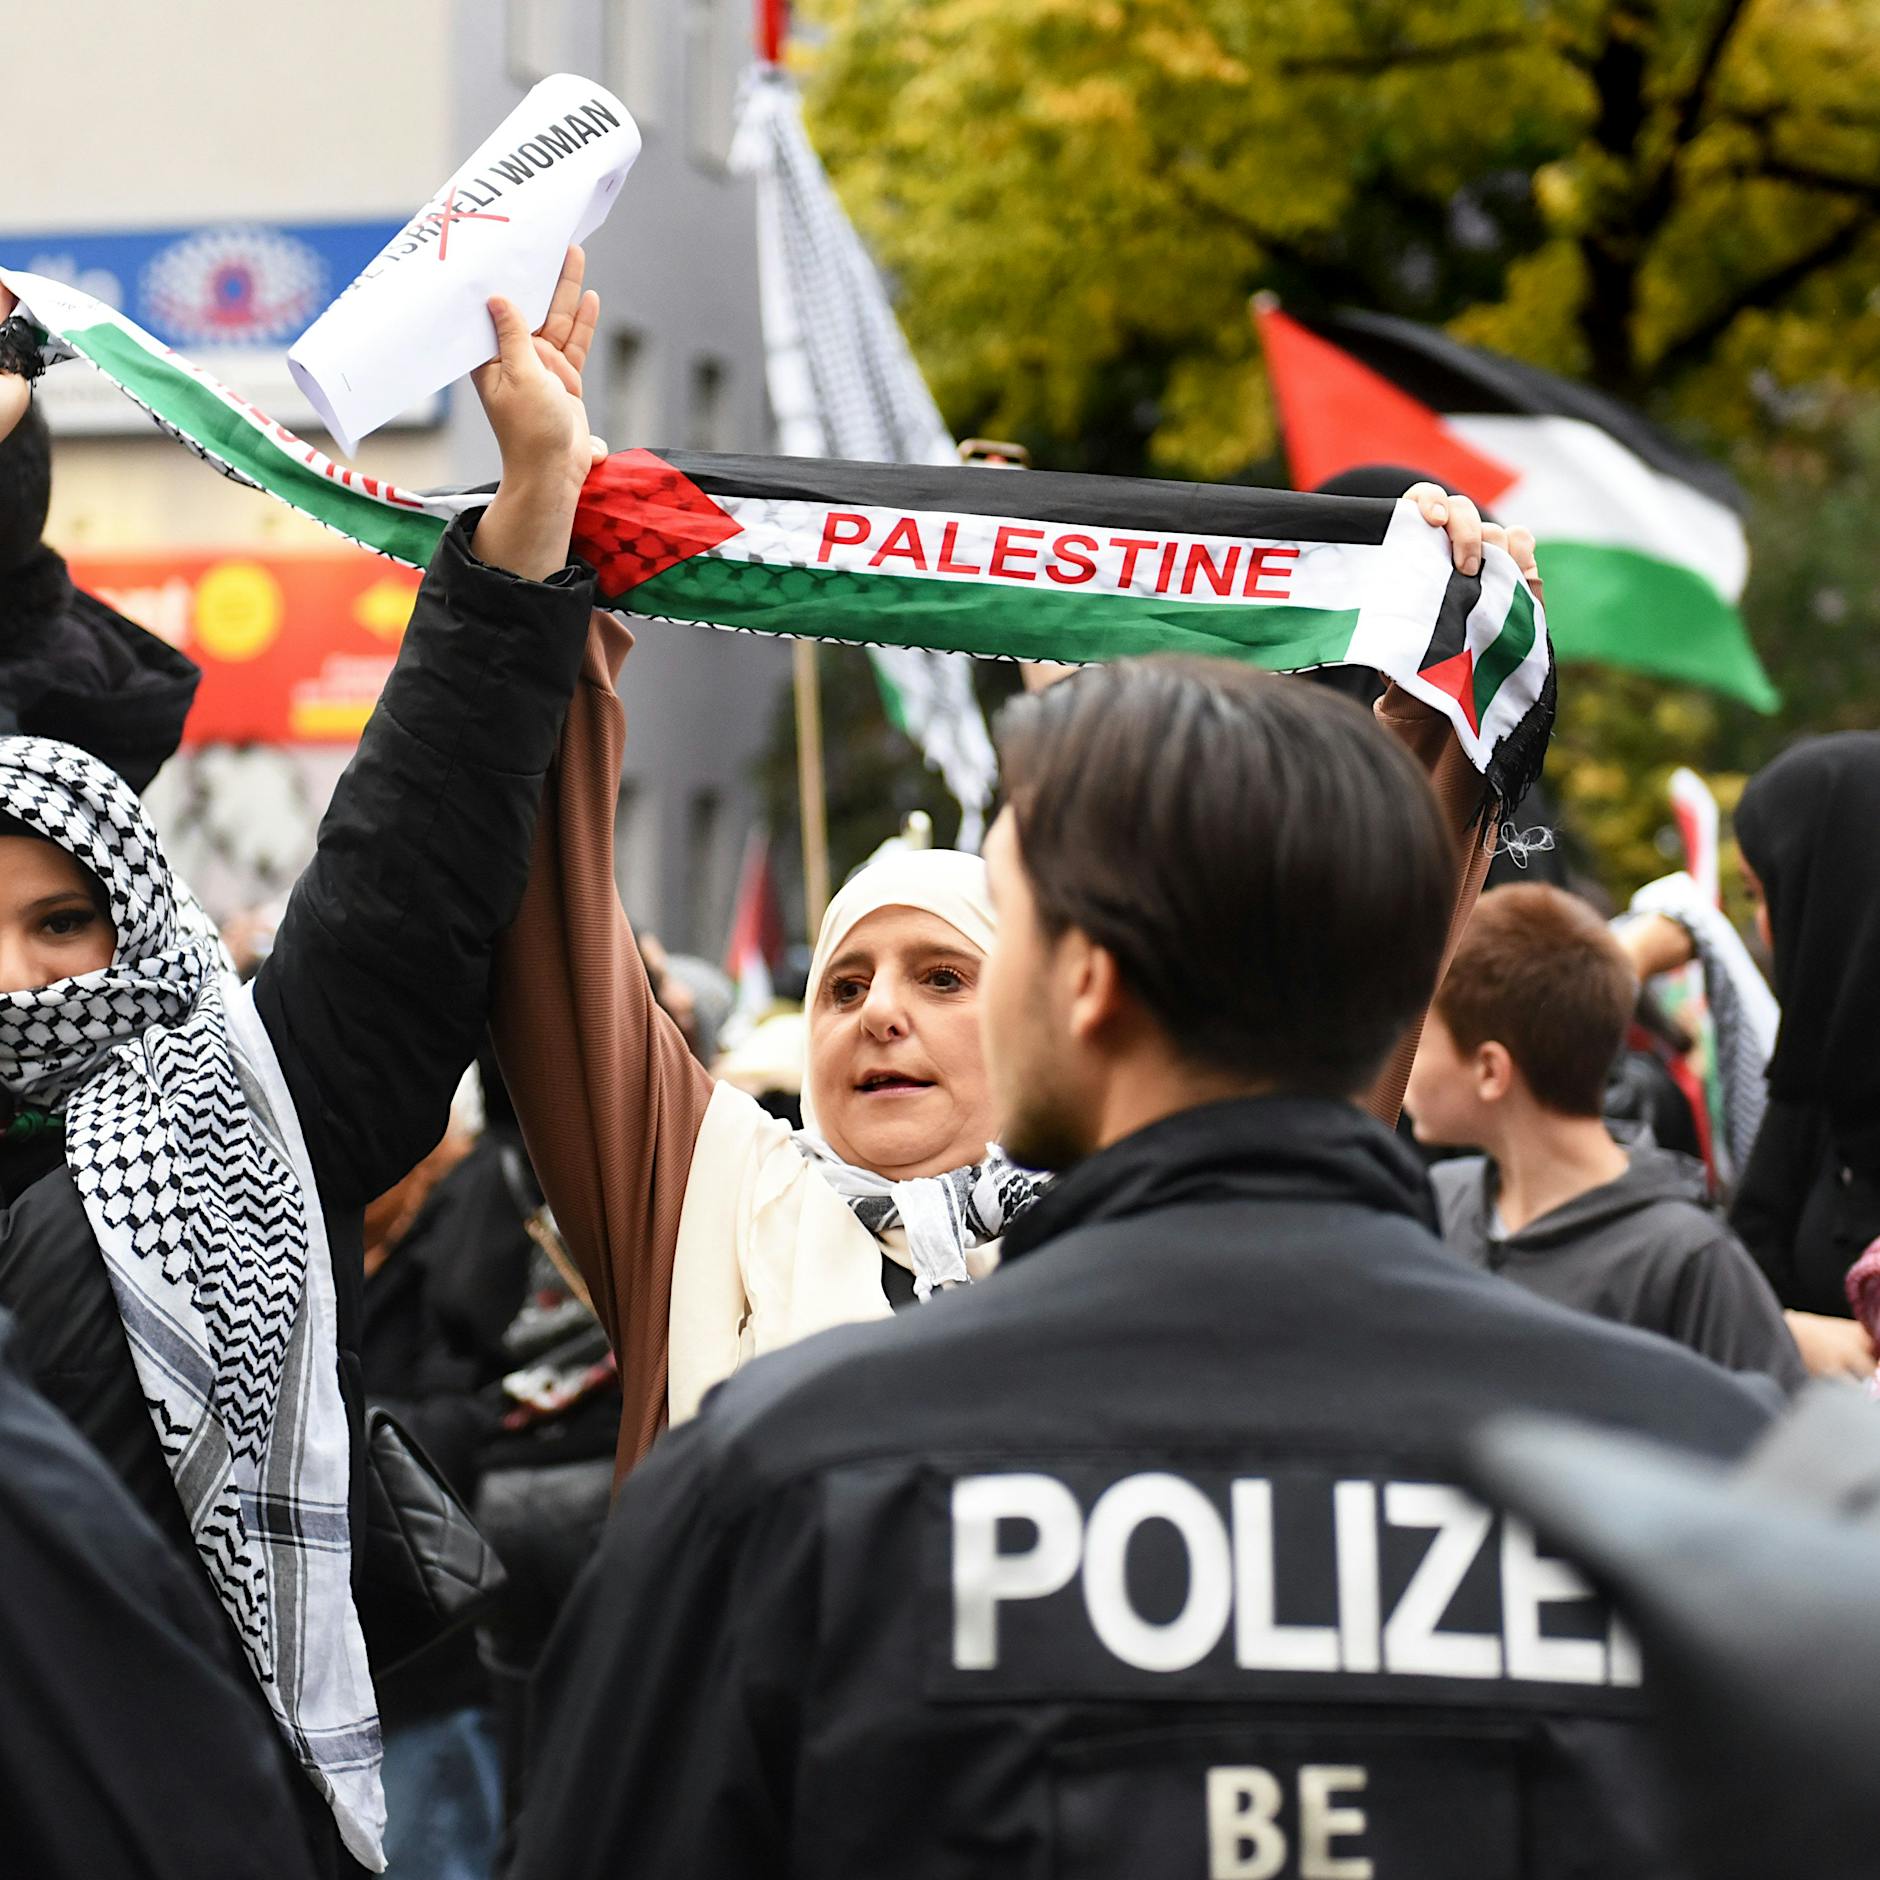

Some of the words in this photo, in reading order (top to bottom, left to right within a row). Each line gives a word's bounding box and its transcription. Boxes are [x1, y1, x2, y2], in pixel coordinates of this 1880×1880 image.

[488, 99, 621, 186] WOMAN
[817, 511, 1301, 600] PALESTINE
[1206, 1764, 1374, 1880] BE
